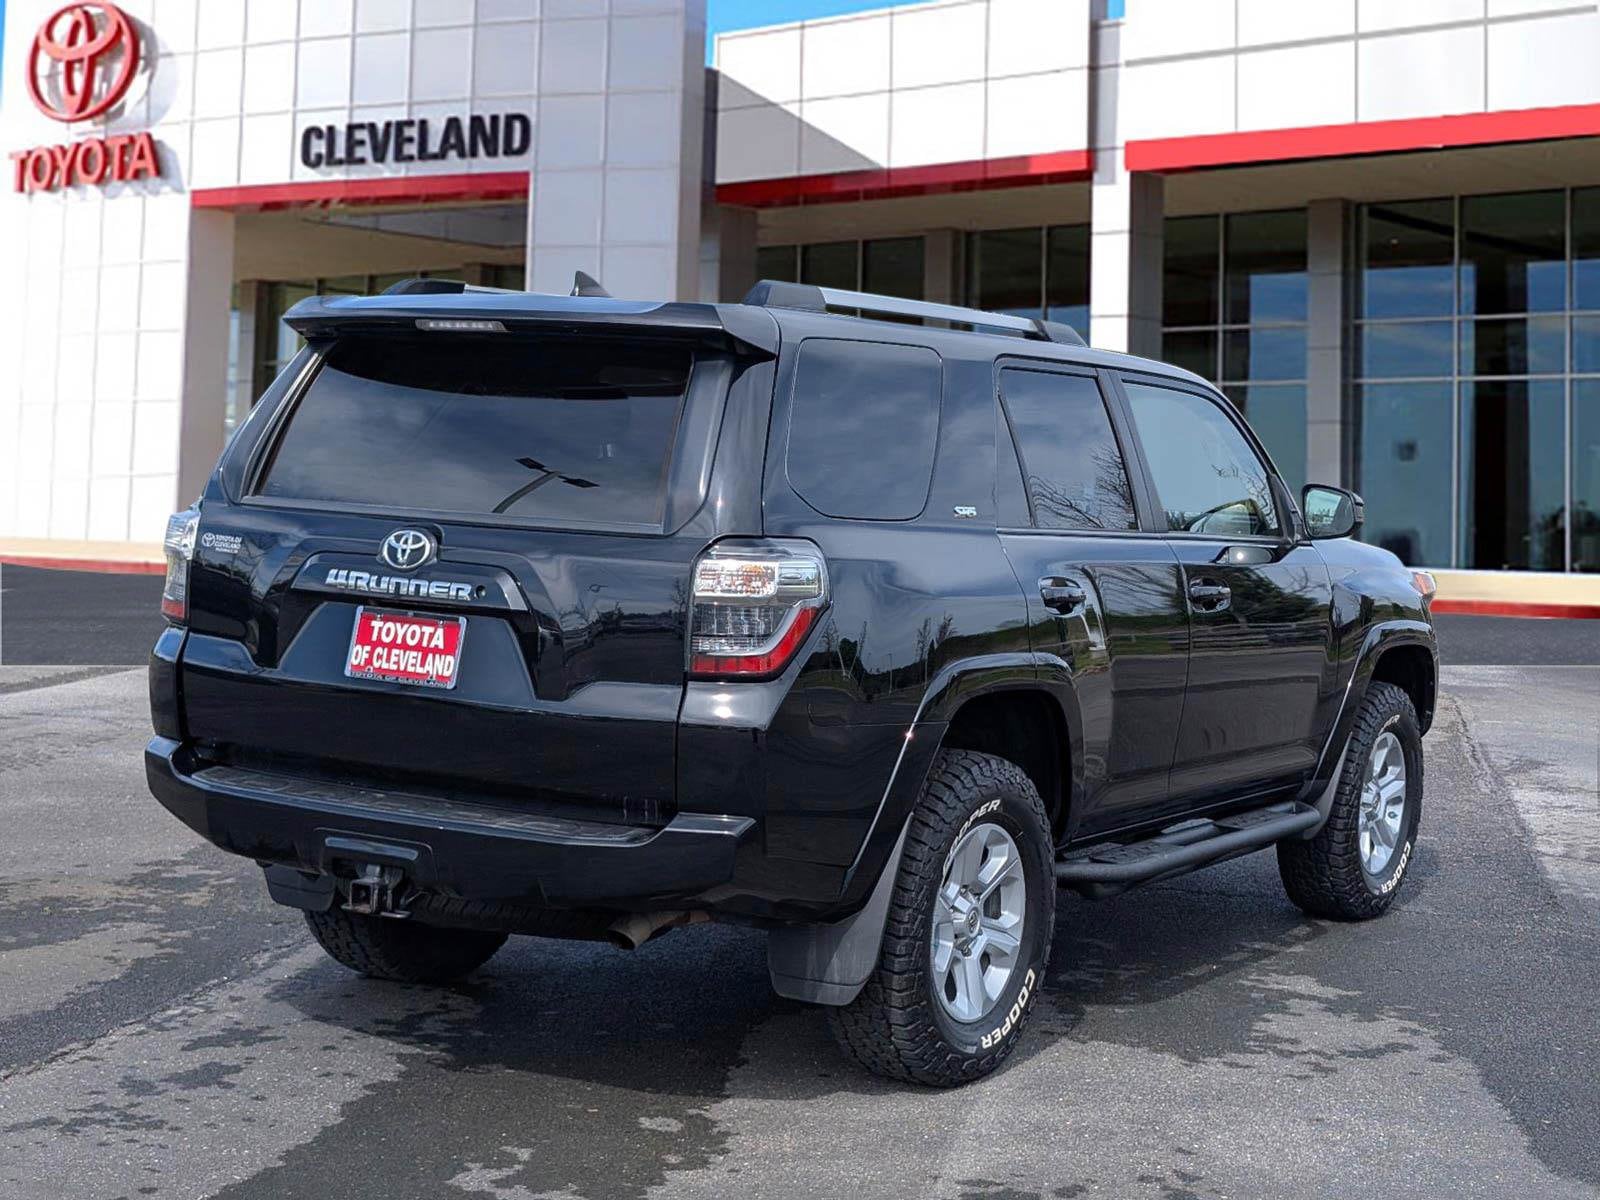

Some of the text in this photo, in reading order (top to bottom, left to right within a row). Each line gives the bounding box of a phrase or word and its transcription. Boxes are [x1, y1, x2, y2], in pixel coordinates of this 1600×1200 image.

[9, 132, 162, 193] TOYOTA
[300, 113, 531, 168] CLEVELAND
[351, 644, 455, 677] OF CLEVELAND
[370, 620, 445, 650] TOYOTA
[1381, 841, 1411, 893] COOPER
[981, 968, 1036, 1049] COOPER
